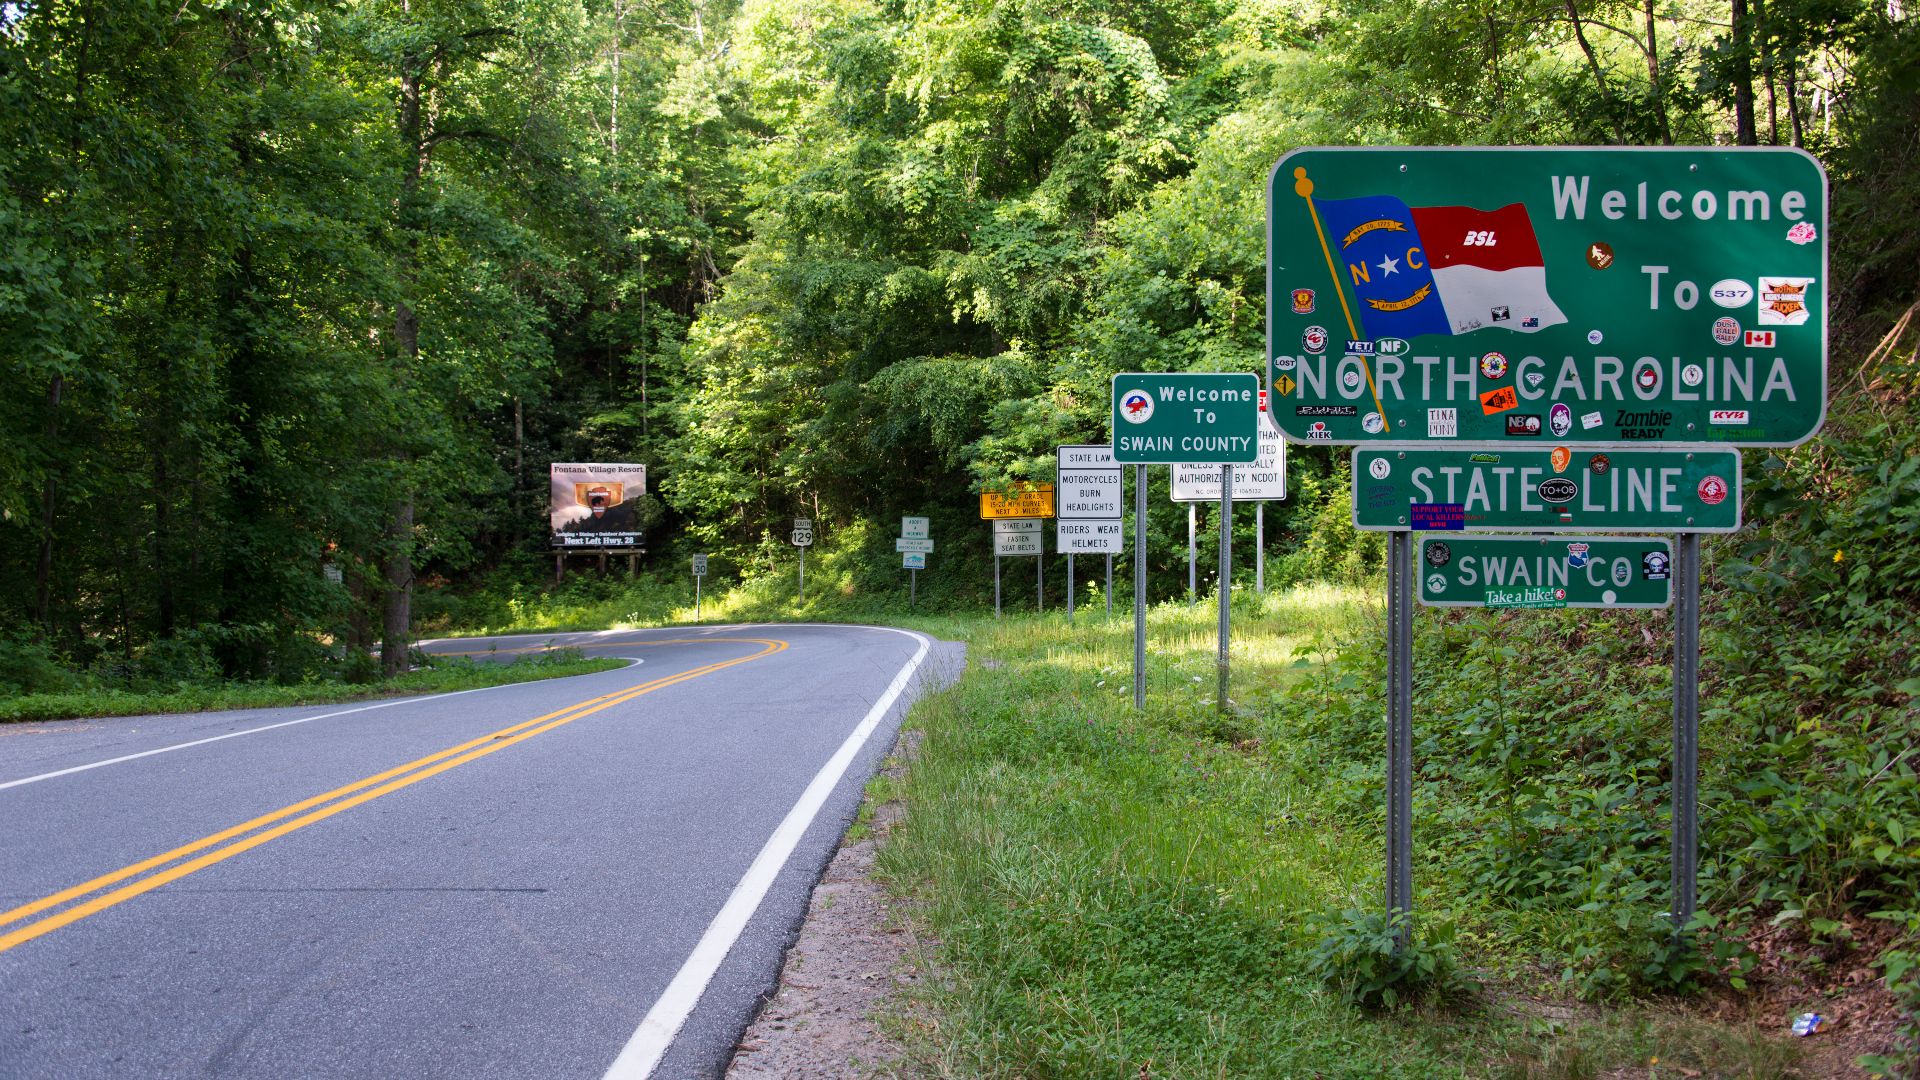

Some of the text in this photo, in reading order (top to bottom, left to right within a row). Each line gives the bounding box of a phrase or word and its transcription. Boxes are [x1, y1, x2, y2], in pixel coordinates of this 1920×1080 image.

[1551, 175, 1806, 220] Welcome
[1463, 230, 1497, 247] BSL
[1350, 247, 1424, 286] N C
[1641, 265, 1699, 310] To
[1774, 284, 1799, 294] MOTHER
[1714, 290, 1748, 298] 537
[1773, 301, 1800, 314] FUCKER
[1347, 341, 1374, 351] YETI
[1380, 340, 1401, 352] NF
[1275, 359, 1295, 367] LOST
[1296, 355, 1478, 401] NORTH
[1515, 355, 1797, 401] CAROLINA
[1159, 386, 1252, 402] Welcome
[1193, 408, 1216, 424] To
[1429, 410, 1454, 421] TINA
[1615, 409, 1673, 427] Zombie
[1713, 411, 1745, 419] KYB
[1308, 431, 1331, 439] XIEK
[1621, 428, 1665, 439] READY
[1120, 436, 1174, 452] SWAIN
[1181, 436, 1252, 452] COUNTY
[1069, 454, 1111, 463] STATE LAW
[588, 466, 617, 474] Village
[1062, 475, 1118, 484] MOTORCYCLES
[1235, 473, 1246, 482] BY
[1252, 473, 1279, 483] NCDOT
[1079, 489, 1101, 498] BURN
[1409, 466, 1543, 513] STATE
[1582, 466, 1683, 513] LINE
[1541, 486, 1575, 495] TO+OB
[1066, 503, 1114, 511] HEADLIGHTS
[1411, 505, 1465, 513] SUPPORT YOUR
[1411, 513, 1435, 521] LOCAL
[1436, 513, 1465, 521] KILLERS
[1060, 525, 1119, 534] RIDERS WEAR
[603, 537, 623, 546] Hwy.
[793, 532, 811, 542] 129
[1071, 539, 1108, 548] HELMETS
[695, 565, 706, 574] 30
[1457, 555, 1569, 587] SWAIN
[1586, 556, 1633, 588] CO
[1485, 587, 1554, 604] Take a hike!
